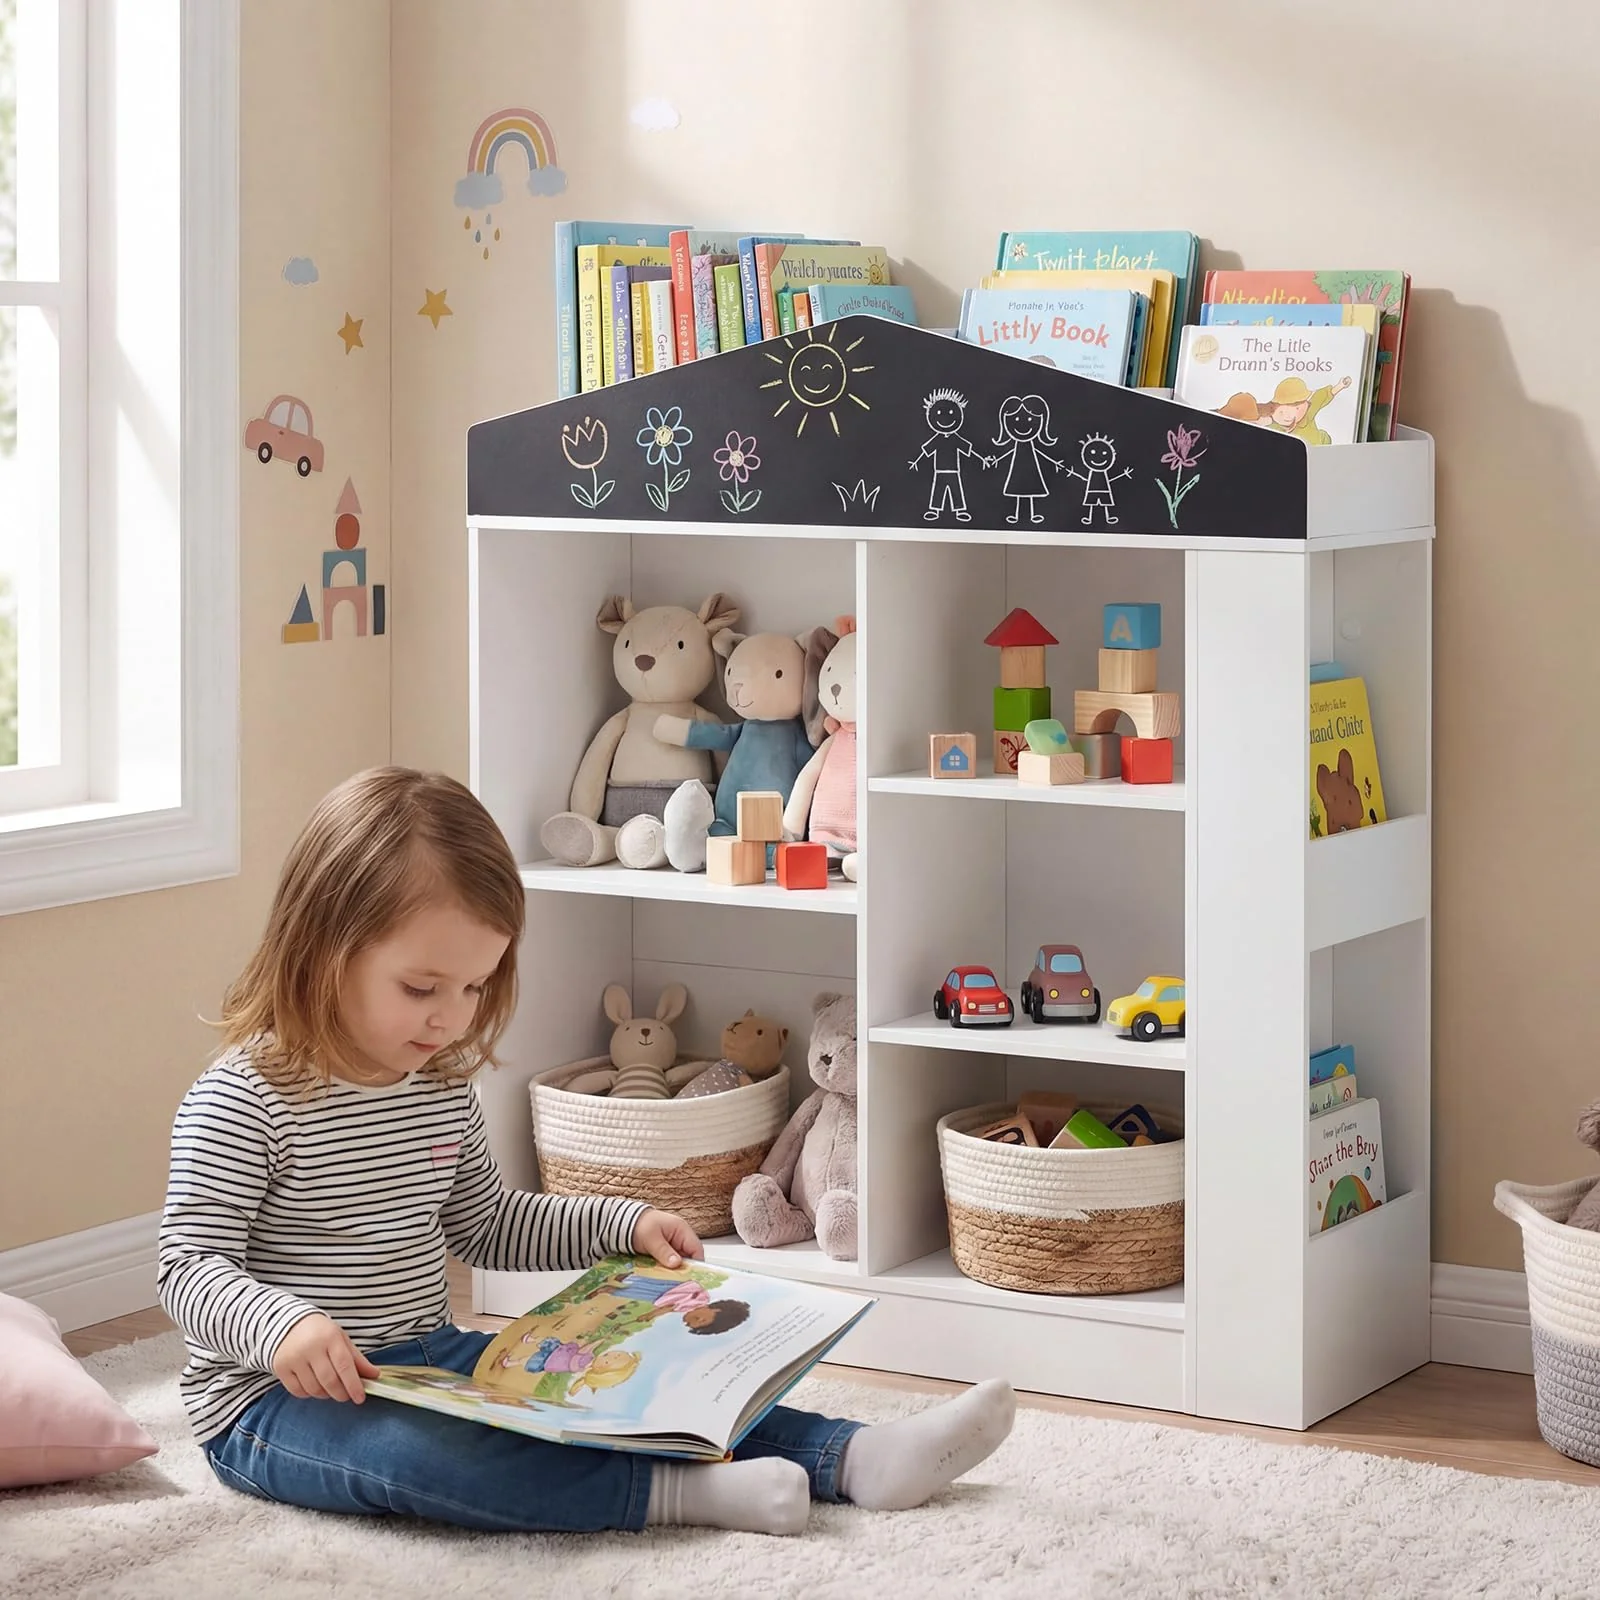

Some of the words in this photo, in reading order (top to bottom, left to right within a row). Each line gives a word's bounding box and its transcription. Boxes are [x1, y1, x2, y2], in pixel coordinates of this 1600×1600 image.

[978, 315, 1042, 346] Littly
[1051, 317, 1111, 348] Book
[1243, 338, 1273, 353] The
[1278, 338, 1311, 353] Litle
[1285, 357, 1333, 372] Books
[1110, 613, 1133, 642] A
[1336, 1140, 1353, 1162] the
